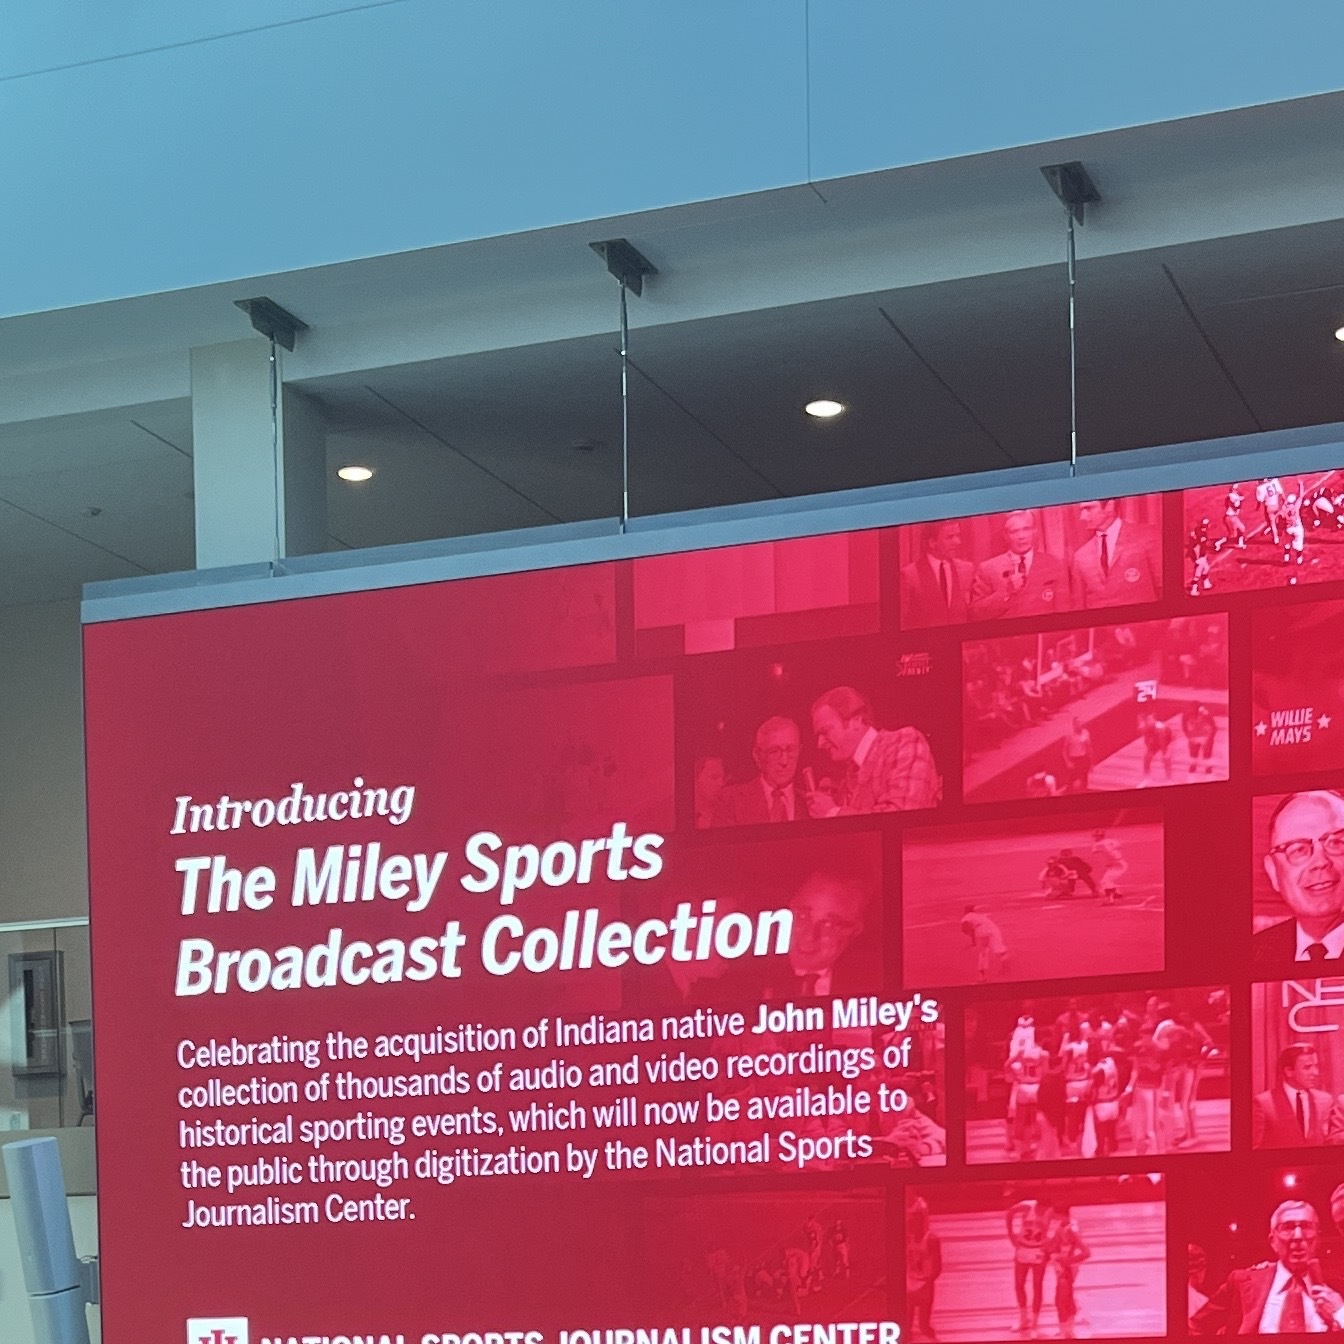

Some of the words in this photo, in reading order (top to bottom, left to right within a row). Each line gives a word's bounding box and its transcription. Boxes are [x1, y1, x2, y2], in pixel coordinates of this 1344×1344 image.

[1269, 726, 1312, 746] MAYS
[1270, 707, 1314, 728] WILLIE
[169, 776, 416, 835] Introducing
[174, 854, 277, 916] The
[291, 841, 449, 913] Miley
[460, 821, 665, 906] Sports
[174, 920, 467, 997] Broadcast
[481, 899, 794, 976] Collection
[177, 1035, 321, 1069] Celebrating
[325, 1031, 369, 1060] the
[374, 1023, 516, 1063] acquisition
[522, 1018, 549, 1049] of
[556, 1015, 654, 1047] Indiana
[662, 1007, 745, 1040] native
[751, 1002, 824, 1034] John
[832, 993, 939, 1032] Miley's
[178, 1076, 298, 1109] collection
[304, 1072, 331, 1102] of
[334, 1065, 471, 1100] thousands
[476, 1062, 503, 1093] of
[509, 1059, 583, 1091] audio
[589, 1054, 639, 1087] and
[645, 1051, 719, 1083] video
[727, 1043, 876, 1079] recordings
[883, 1036, 912, 1069] of
[179, 1114, 293, 1148] historical
[299, 1111, 406, 1149] sporting
[411, 1106, 504, 1137] events,
[508, 1100, 586, 1132] which
[592, 1096, 637, 1128] will
[644, 1100, 700, 1126] now
[707, 1092, 740, 1122] be
[747, 1084, 871, 1120] available
[877, 1083, 909, 1113] to
[180, 1160, 222, 1189] the
[227, 1156, 303, 1194] public
[307, 1150, 409, 1188] through
[415, 1145, 560, 1185] digitization
[566, 1142, 599, 1179] by
[604, 1140, 649, 1170] the
[656, 1132, 770, 1168] National
[778, 1129, 873, 1169] Sports
[181, 1196, 319, 1228] Journalism
[325, 1192, 416, 1223] Center.
